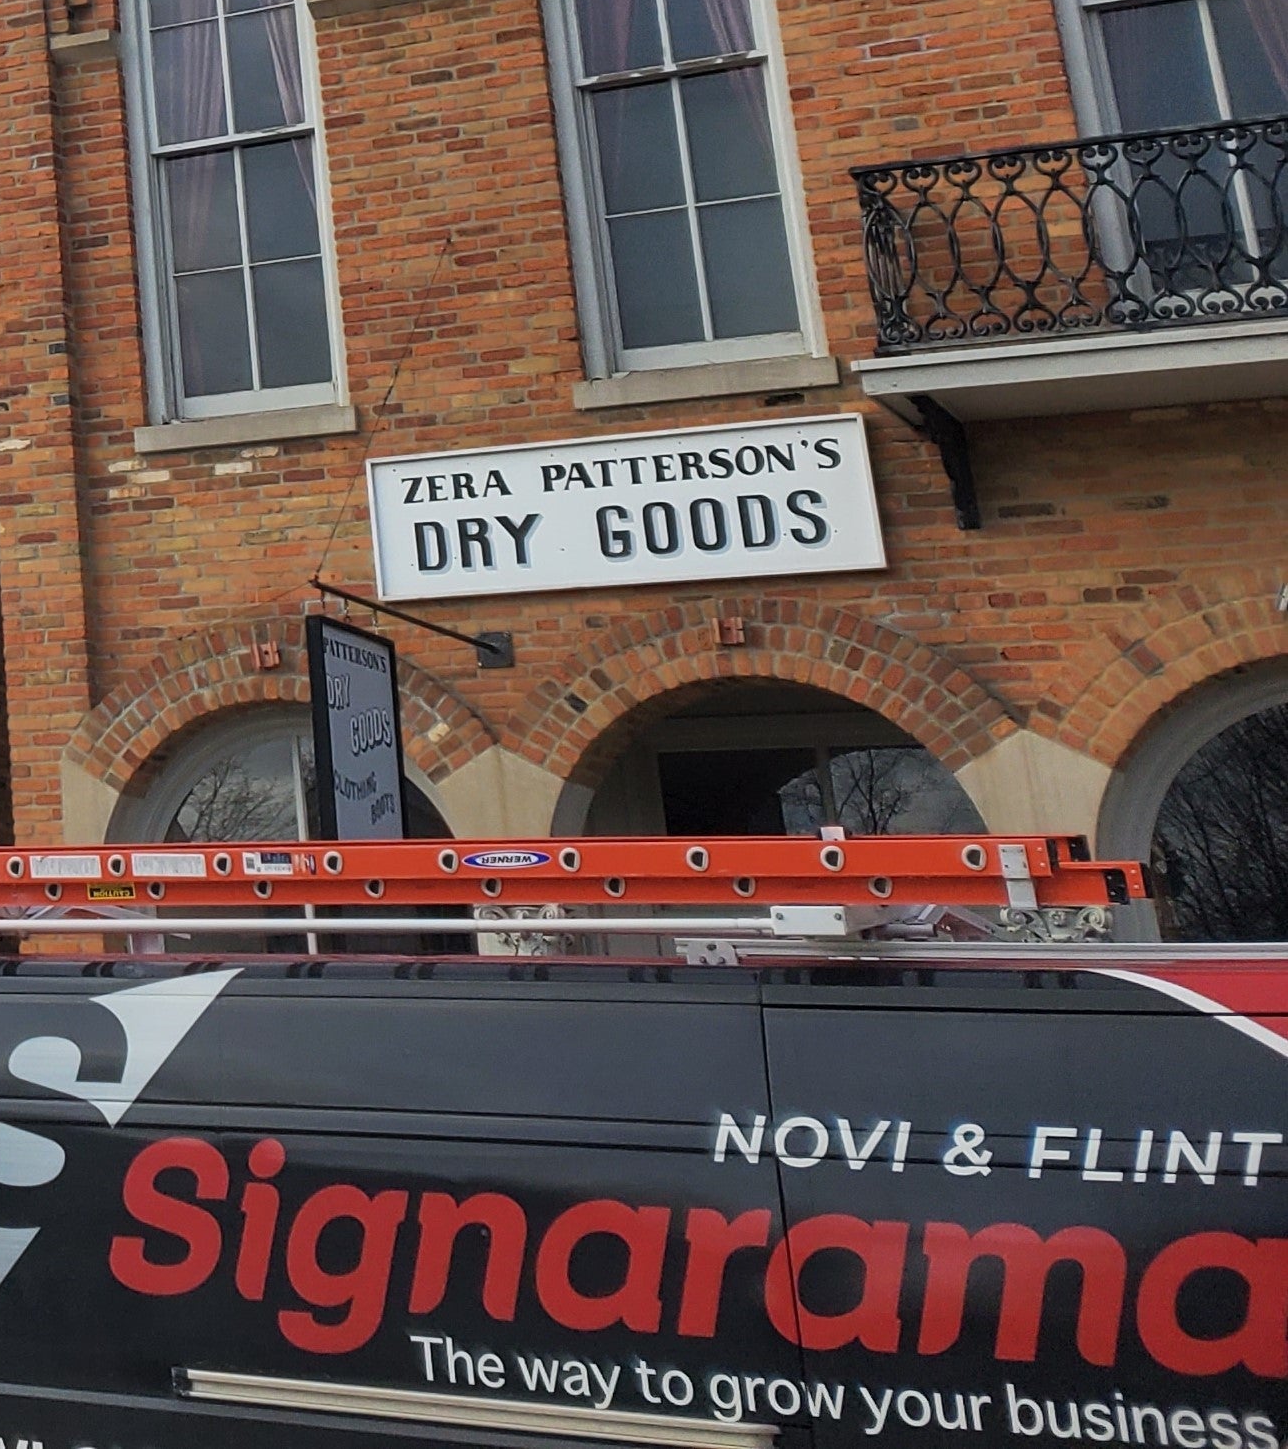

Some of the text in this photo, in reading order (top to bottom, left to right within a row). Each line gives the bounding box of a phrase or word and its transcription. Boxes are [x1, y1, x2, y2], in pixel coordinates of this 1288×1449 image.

[400, 438, 842, 504] ZERA PATTERSON'S
[413, 489, 831, 574] DRY GOODS
[323, 636, 387, 673] PATTERSON'S
[326, 672, 351, 710] DRY
[350, 707, 392, 757] GOODS
[334, 769, 377, 802] CLOTHING
[371, 793, 395, 825] BOOTS
[482, 855, 532, 864] WERNER
[713, 1112, 1284, 1187] NOVI & FLINT
[109, 1135, 1288, 1379] Signarama
[409, 1334, 506, 1389] The
[517, 1354, 621, 1409] way
[634, 1358, 694, 1406] to
[709, 1372, 845, 1423] grow
[859, 1385, 992, 1435] your
